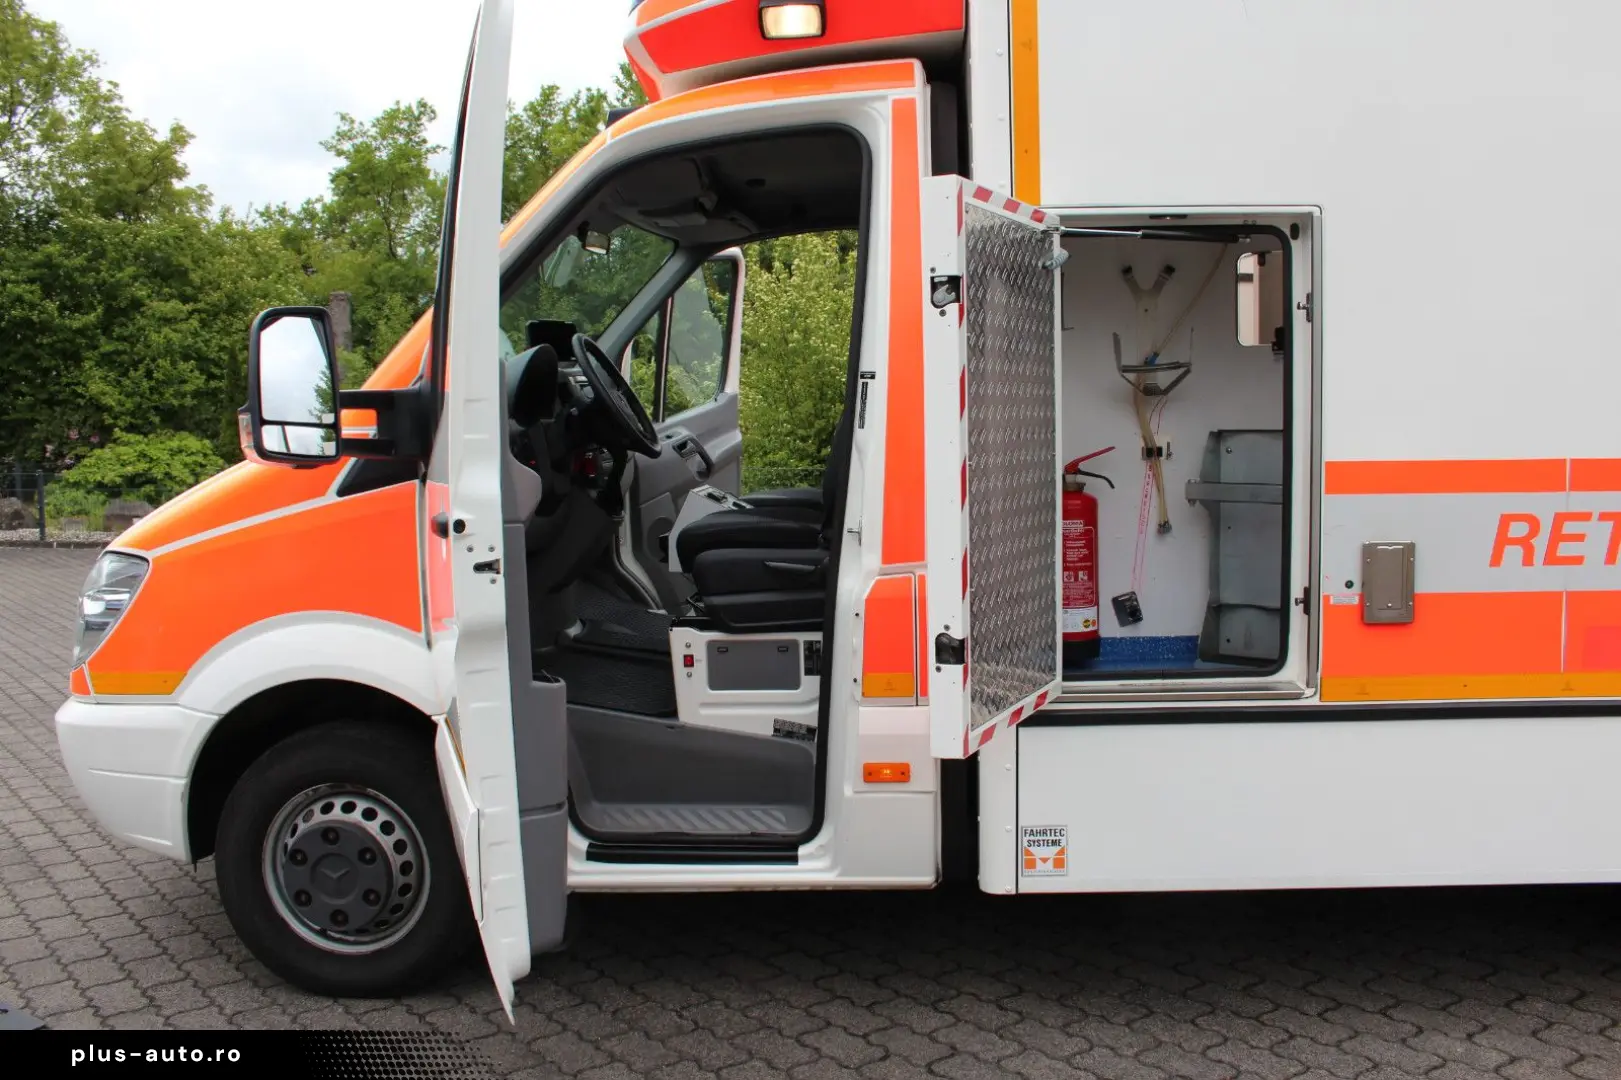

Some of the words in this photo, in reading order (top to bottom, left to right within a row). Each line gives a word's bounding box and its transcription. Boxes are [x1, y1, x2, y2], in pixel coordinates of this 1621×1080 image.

[1489, 511, 1621, 567] RET
[1023, 828, 1065, 838] FAHRTEC
[1026, 839, 1062, 848] SYSTEME
